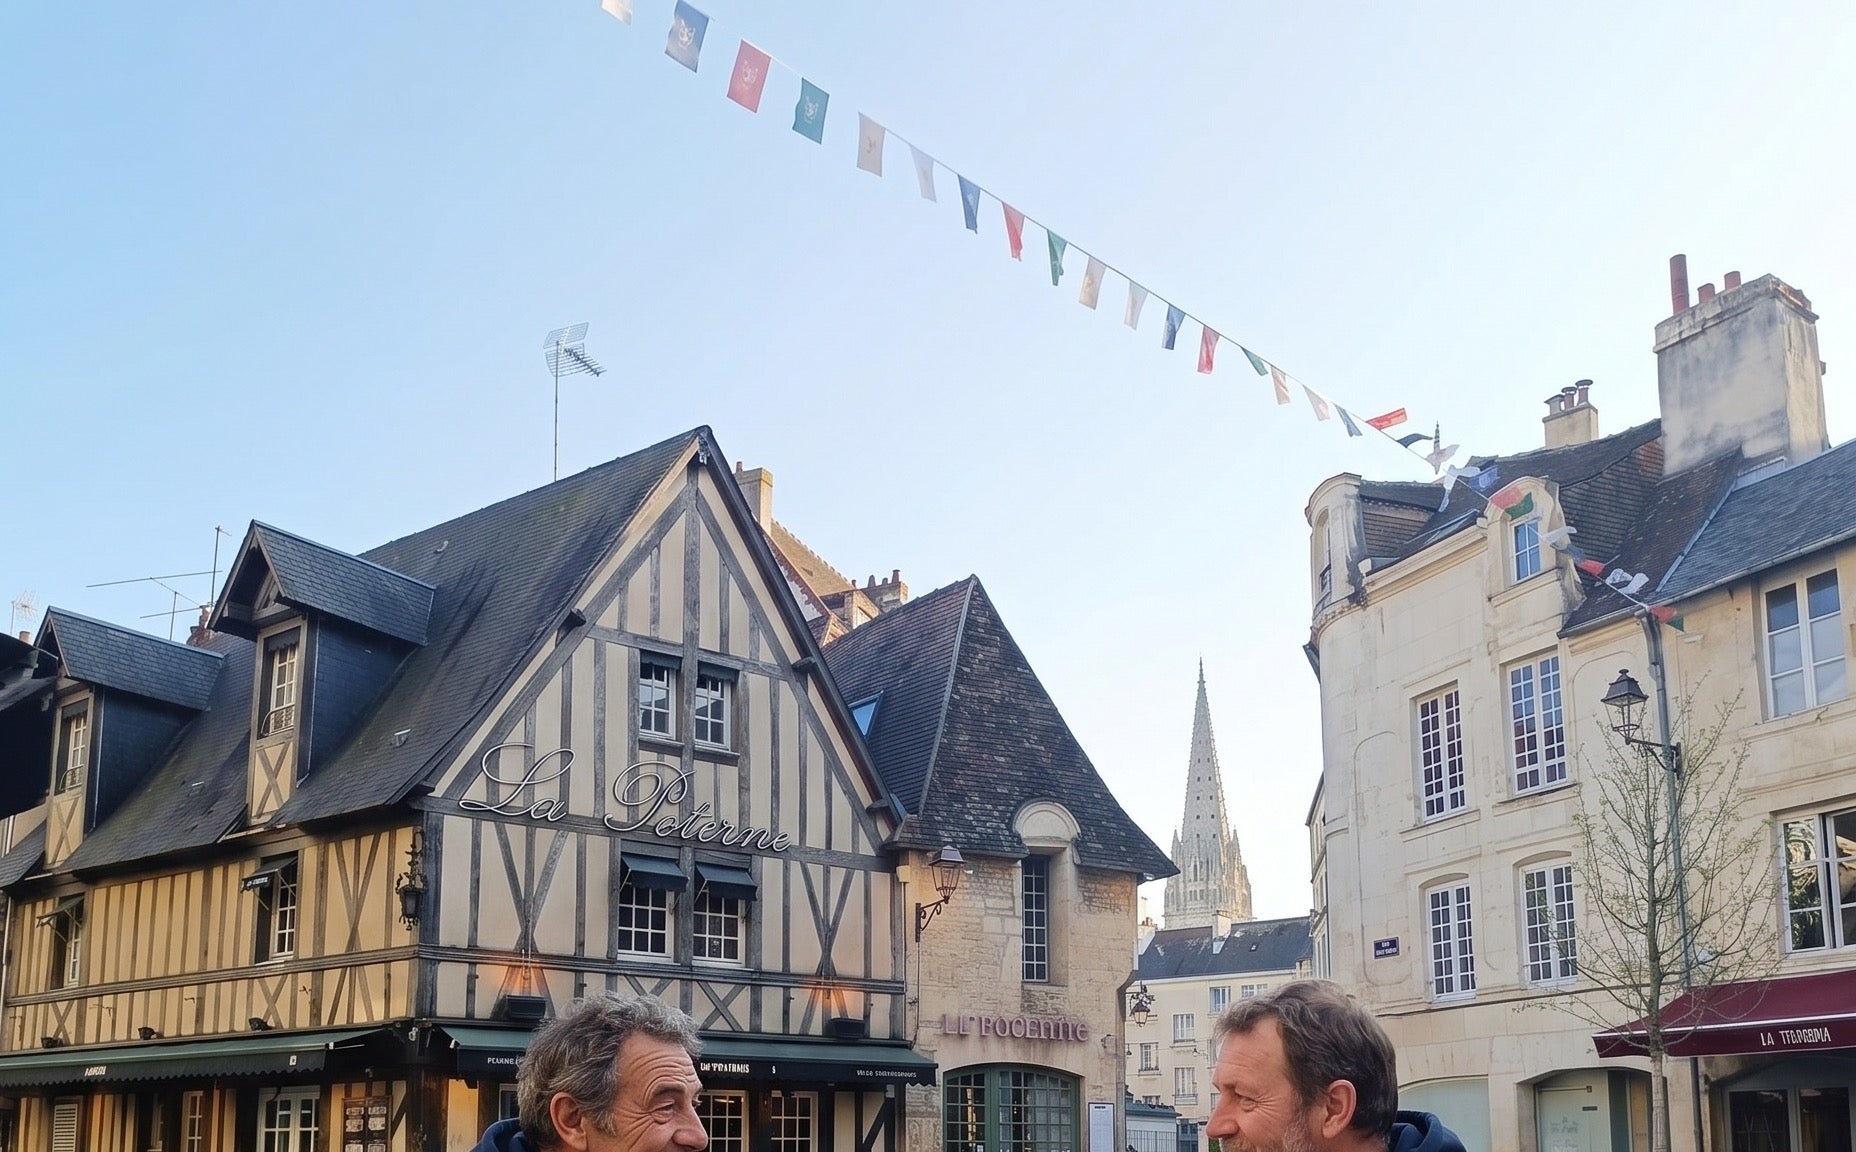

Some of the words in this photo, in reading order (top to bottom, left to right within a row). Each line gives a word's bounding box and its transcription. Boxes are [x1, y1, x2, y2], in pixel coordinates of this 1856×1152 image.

[459, 743, 575, 822] La
[603, 760, 792, 852] Poterne
[1760, 1032, 1775, 1046] LA
